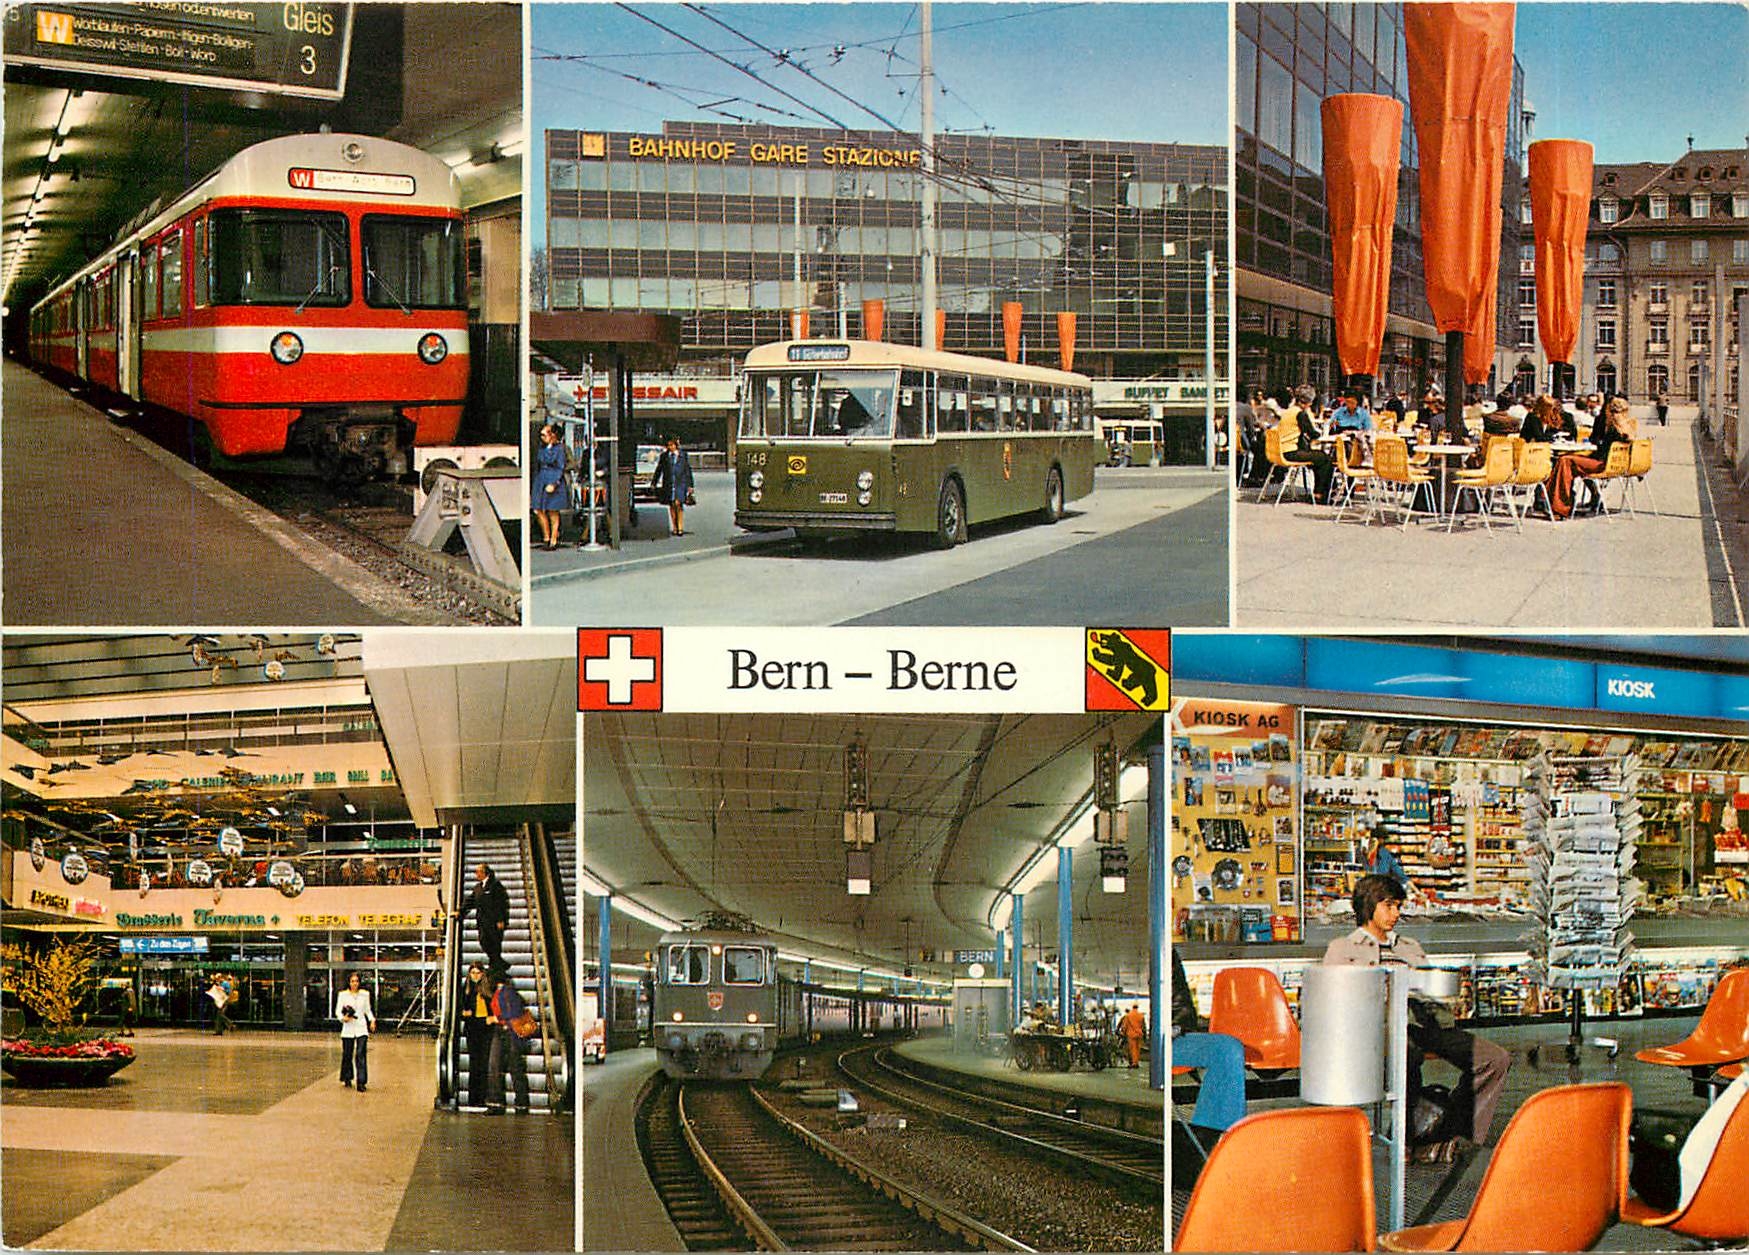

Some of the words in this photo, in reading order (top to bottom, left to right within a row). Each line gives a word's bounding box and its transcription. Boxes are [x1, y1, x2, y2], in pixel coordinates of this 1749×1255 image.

[40, 11, 69, 43] W
[284, 2, 334, 35] Gleis
[301, 45, 316, 75] 3
[629, 138, 736, 161] BAHNHOF
[750, 143, 808, 164] GARE
[293, 172, 310, 187] W
[592, 386, 698, 399] SSSAIR
[746, 452, 767, 466] 148
[1607, 678, 1656, 698] KIOSK
[1194, 711, 1250, 727] KIOSK
[1257, 714, 1279, 728] AG
[297, 914, 350, 926] TELEFON
[358, 913, 422, 926] TELEGRAF
[960, 950, 994, 963] BERN
